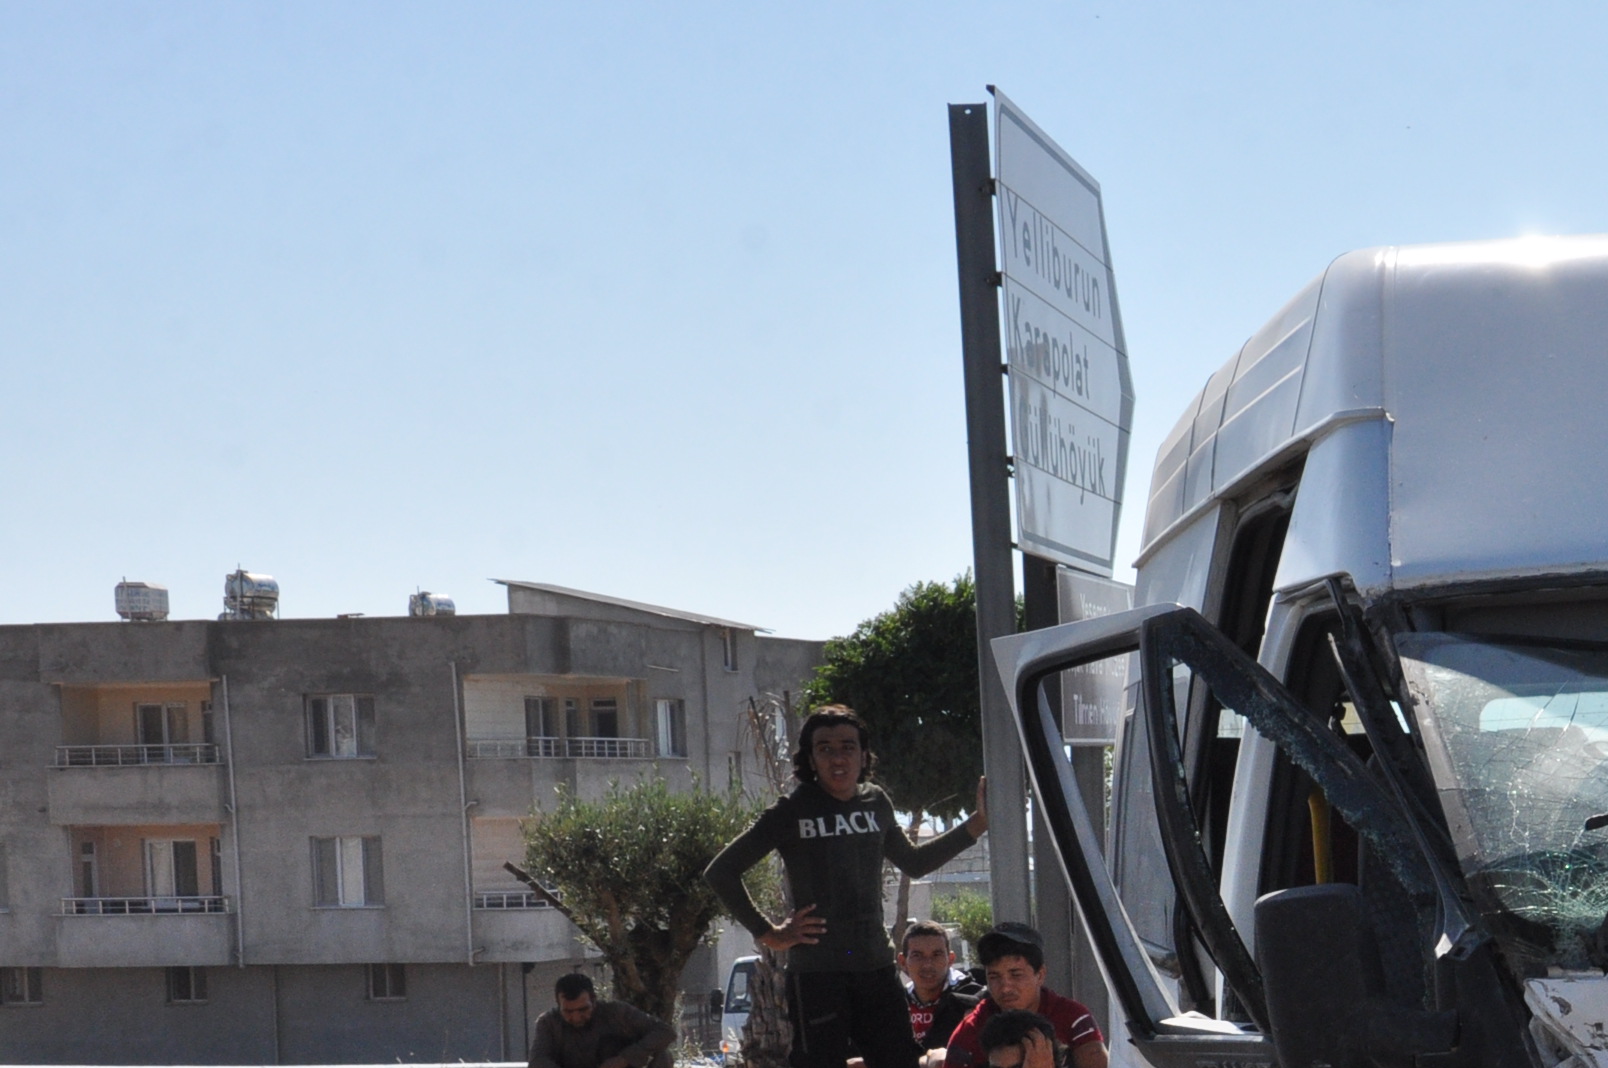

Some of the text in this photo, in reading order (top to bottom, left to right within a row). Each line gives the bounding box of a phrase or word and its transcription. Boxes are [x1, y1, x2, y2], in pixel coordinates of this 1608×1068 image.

[1005, 186, 1102, 320] Yelliburun
[1011, 292, 1090, 400] Karapolat
[798, 811, 881, 839] BLACK
